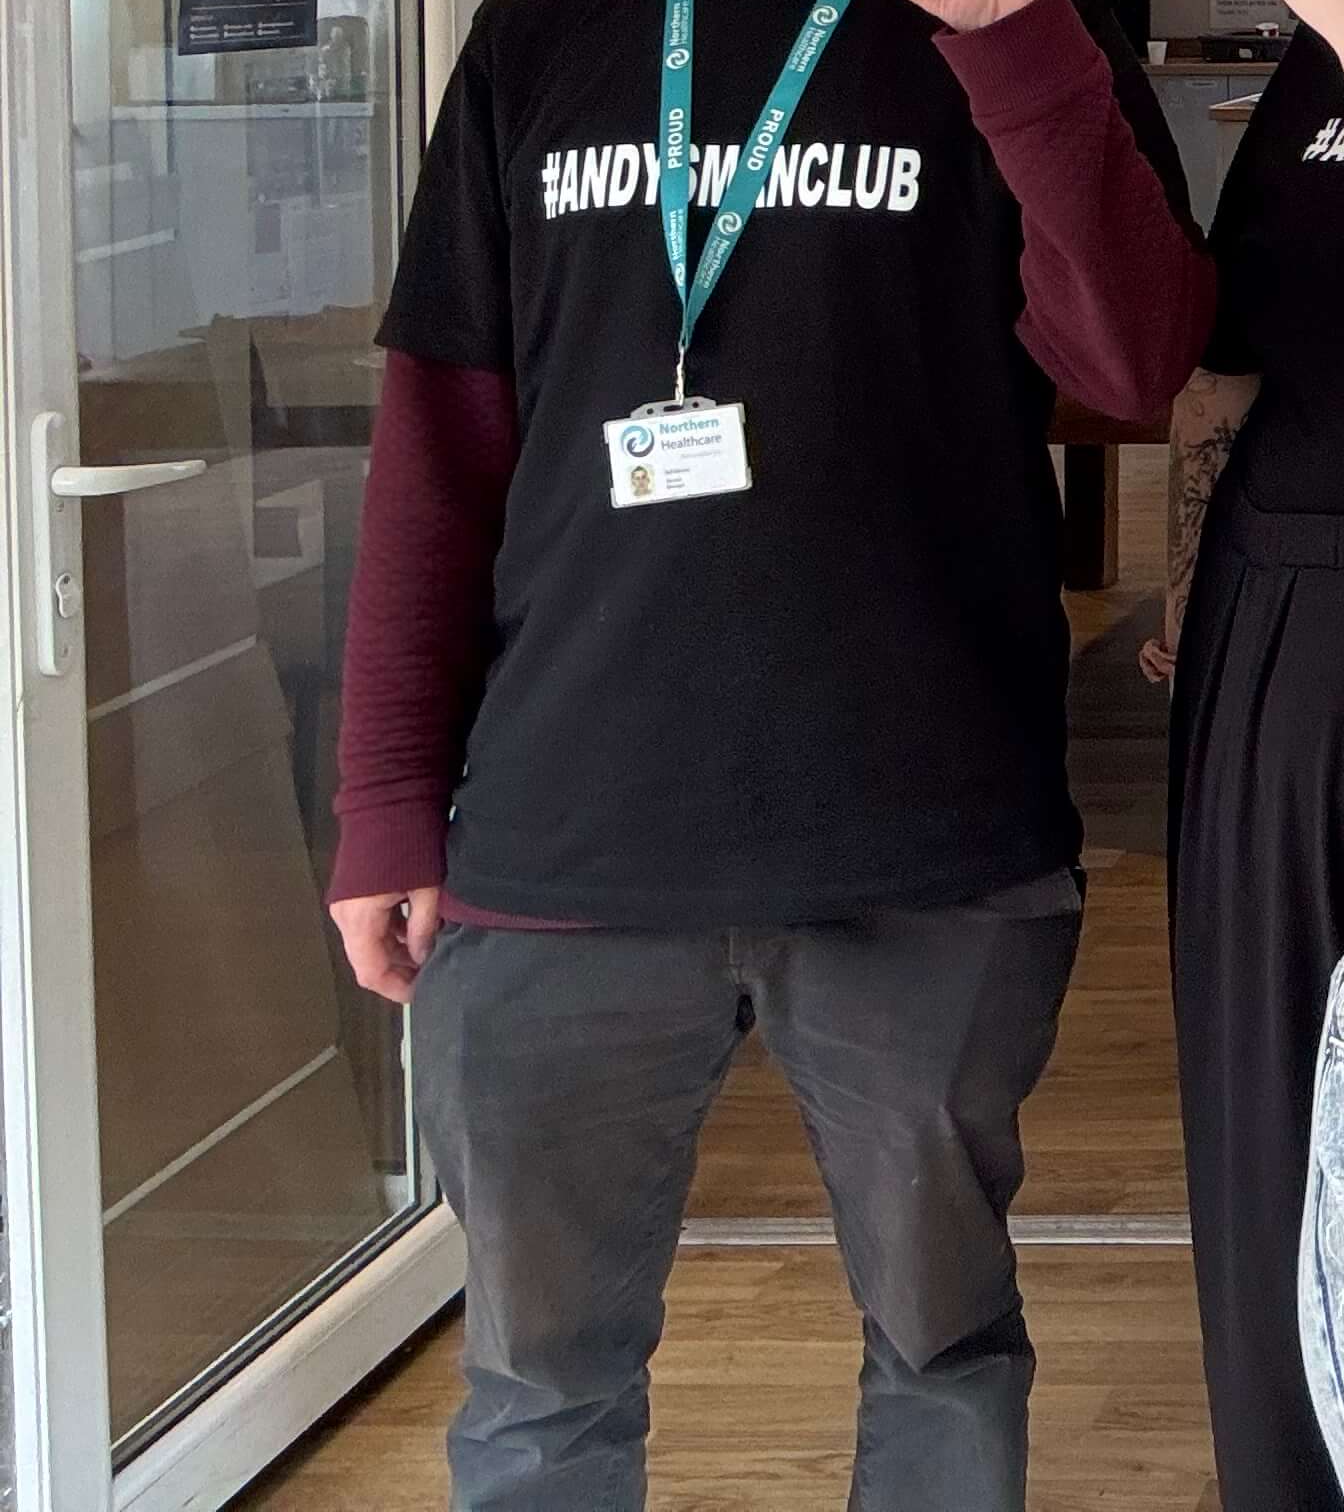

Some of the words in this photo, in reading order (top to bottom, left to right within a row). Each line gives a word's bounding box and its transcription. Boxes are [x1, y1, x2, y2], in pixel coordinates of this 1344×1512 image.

[796, 29, 827, 72] Northern
[668, 107, 685, 170] PROUD
[747, 108, 785, 172] PROUD
[542, 143, 922, 220] #ANDYMNCLUB
[659, 416, 721, 436] Northern
[660, 433, 722, 451] Healthcare
